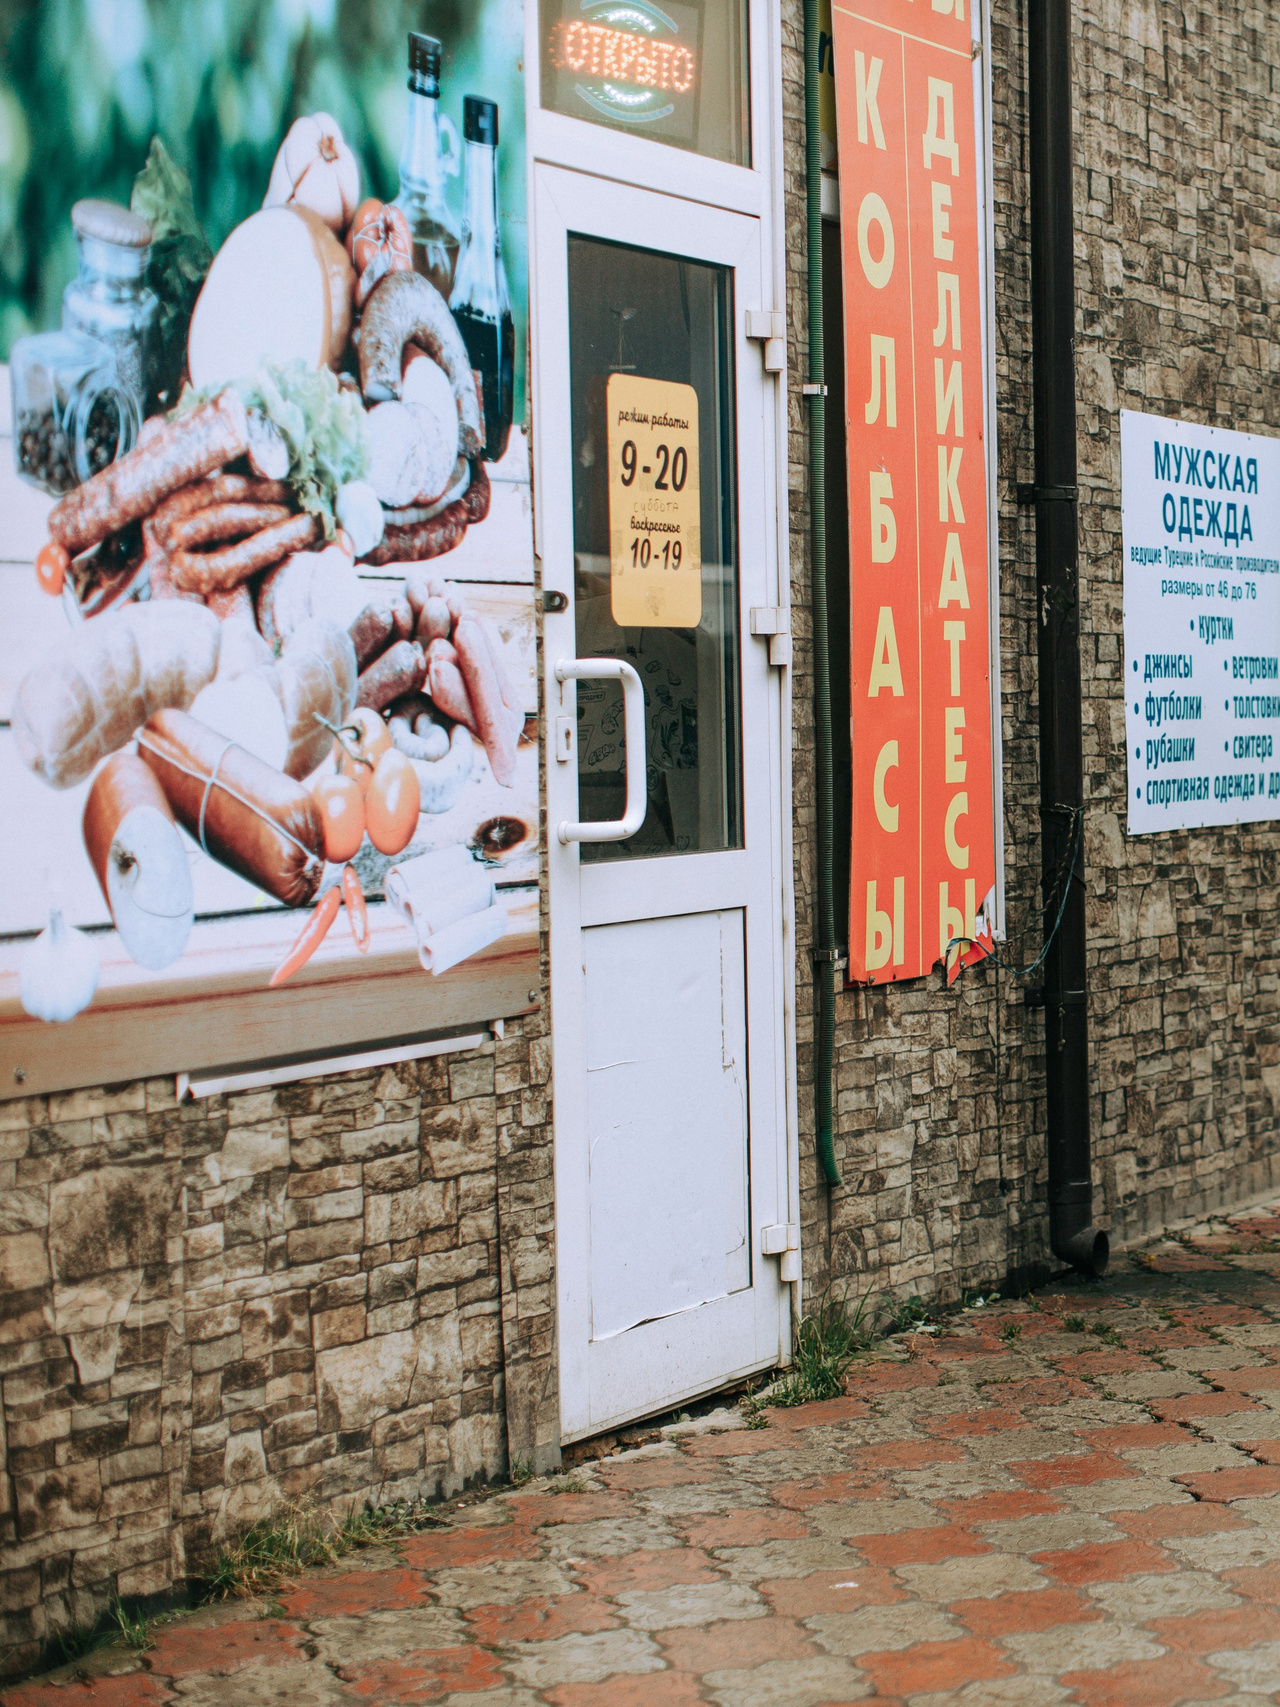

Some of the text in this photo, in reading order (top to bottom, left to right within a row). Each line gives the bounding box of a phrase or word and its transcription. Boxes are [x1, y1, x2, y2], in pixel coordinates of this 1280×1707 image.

[566, 21, 695, 92] ОТКРЫТО
[618, 407, 689, 431] режим работы
[1154, 440, 1258, 494] МУЖСКАЯ
[854, 49, 905, 971] КОЛБАСЫ
[922, 76, 976, 960] ДЕЛИКАТЕСЫ
[1162, 492, 1253, 548] ОДЕЖДА
[1131, 546, 1162, 566] ведущие
[1164, 546, 1193, 569] Турецкие
[1200, 549, 1233, 571] Российские
[1236, 556, 1280, 575] производители
[1162, 579, 1257, 602] размеры от 46 до 76
[1199, 615, 1234, 645] куртки
[1144, 654, 1193, 683] джинсы
[1232, 656, 1278, 684] ветровки
[1145, 690, 1202, 727] футболки
[1146, 733, 1195, 770] рубашки
[1233, 734, 1272, 762] свитера
[1146, 776, 1209, 809] спортивная
[1214, 773, 1255, 803] одежда
[1259, 772, 1264, 795] и
